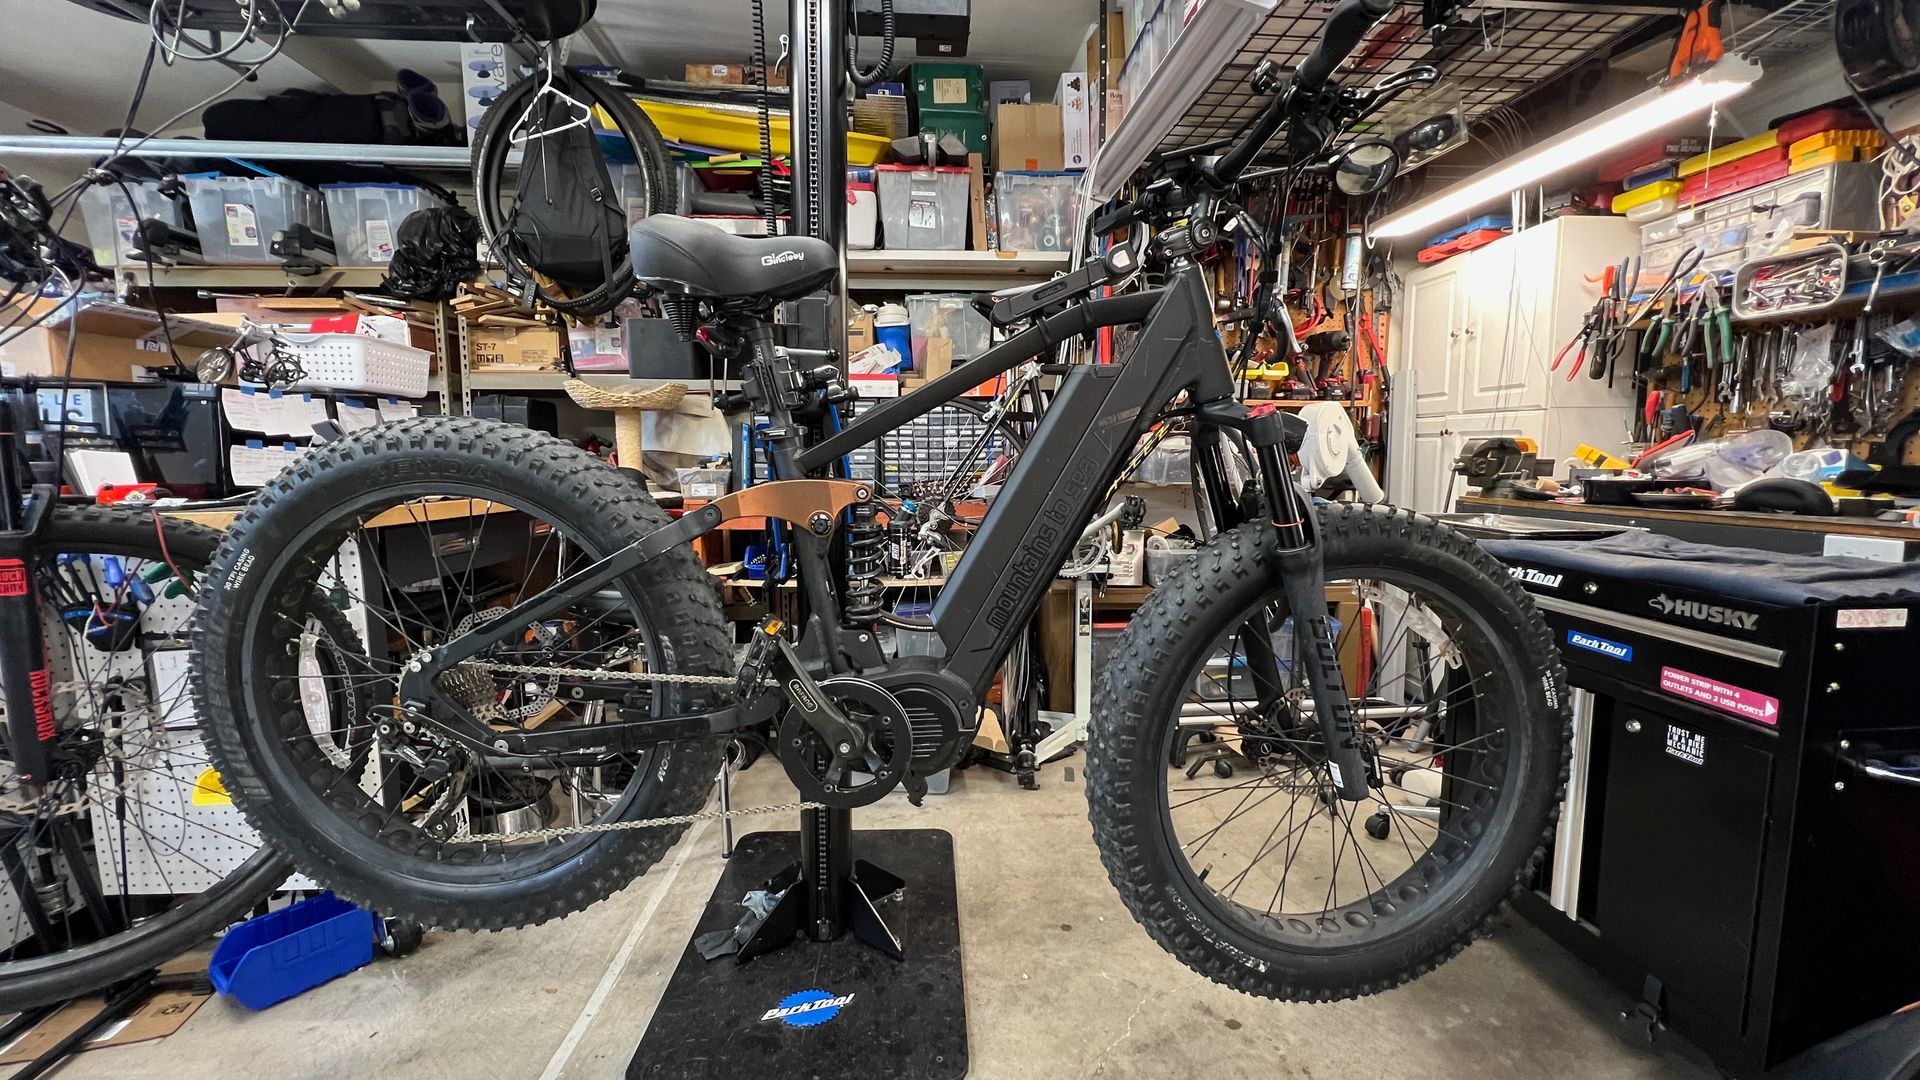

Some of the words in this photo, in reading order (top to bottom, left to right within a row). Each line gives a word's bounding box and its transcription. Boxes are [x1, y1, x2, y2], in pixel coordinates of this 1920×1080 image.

[476, 343, 496, 351] ST-7
[371, 457, 492, 482] KENDA
[986, 519, 1057, 632] mountains
[1045, 498, 1073, 526] to
[1064, 456, 1098, 500] sea
[233, 547, 250, 571] CASING
[227, 570, 238, 582] TPI
[232, 571, 246, 589] WIRE
[240, 555, 255, 572] BEAD
[1508, 566, 1563, 588] rkTool
[223, 581, 232, 591] 30
[1674, 599, 1759, 631] HUSKY
[792, 683, 814, 708] BAFANG
[1663, 670, 1690, 684] POWER
[1690, 679, 1712, 690] STRIP
[1712, 685, 1734, 697] WITH
[1662, 680, 1694, 695] OUTLETS
[1694, 690, 1712, 700] AND
[1719, 698, 1736, 708] USB
[1737, 703, 1765, 717] PORTS
[1668, 724, 1690, 738] TRUST
[1694, 734, 1706, 744] ME
[1680, 736, 1686, 744] A
[1687, 738, 1705, 751] BIKE
[1666, 738, 1704, 758] MECHANIC
